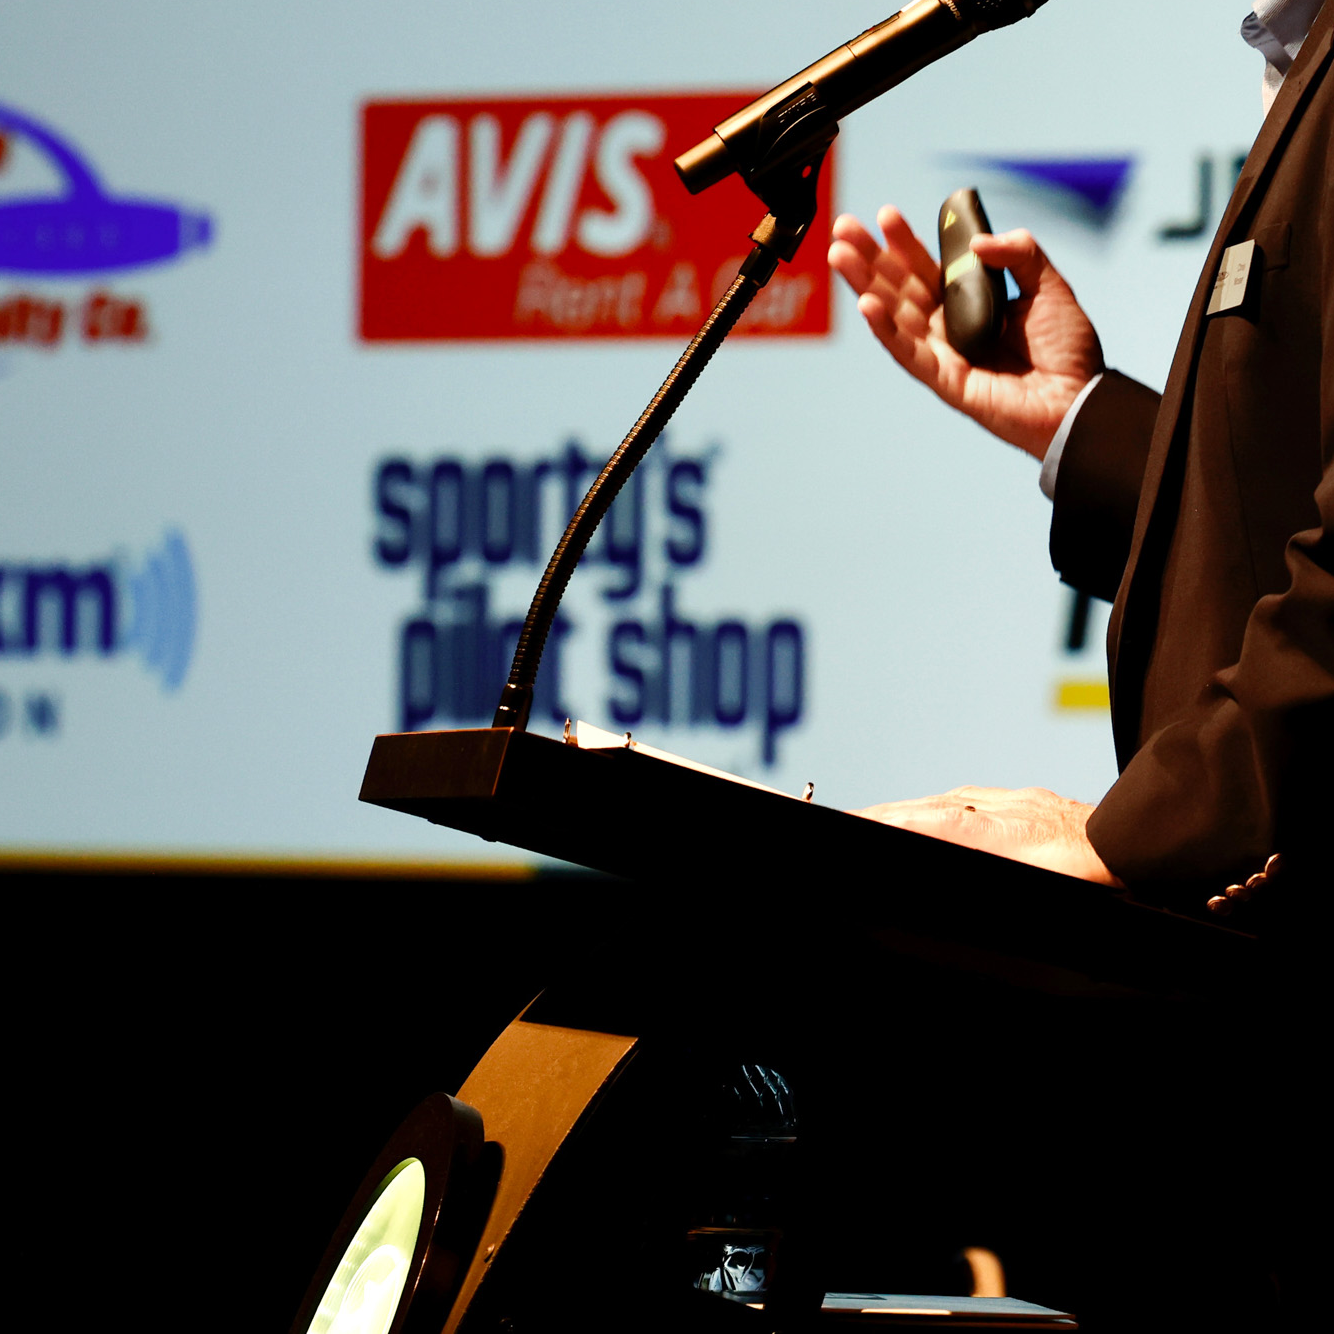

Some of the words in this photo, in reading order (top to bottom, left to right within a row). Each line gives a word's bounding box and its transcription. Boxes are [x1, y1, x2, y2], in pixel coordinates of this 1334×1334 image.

[369, 110, 665, 260] AVIS
[515, 262, 646, 330] Rent
[652, 263, 702, 323] A
[375, 436, 707, 600] sporty's
[607, 584, 807, 766] shop
